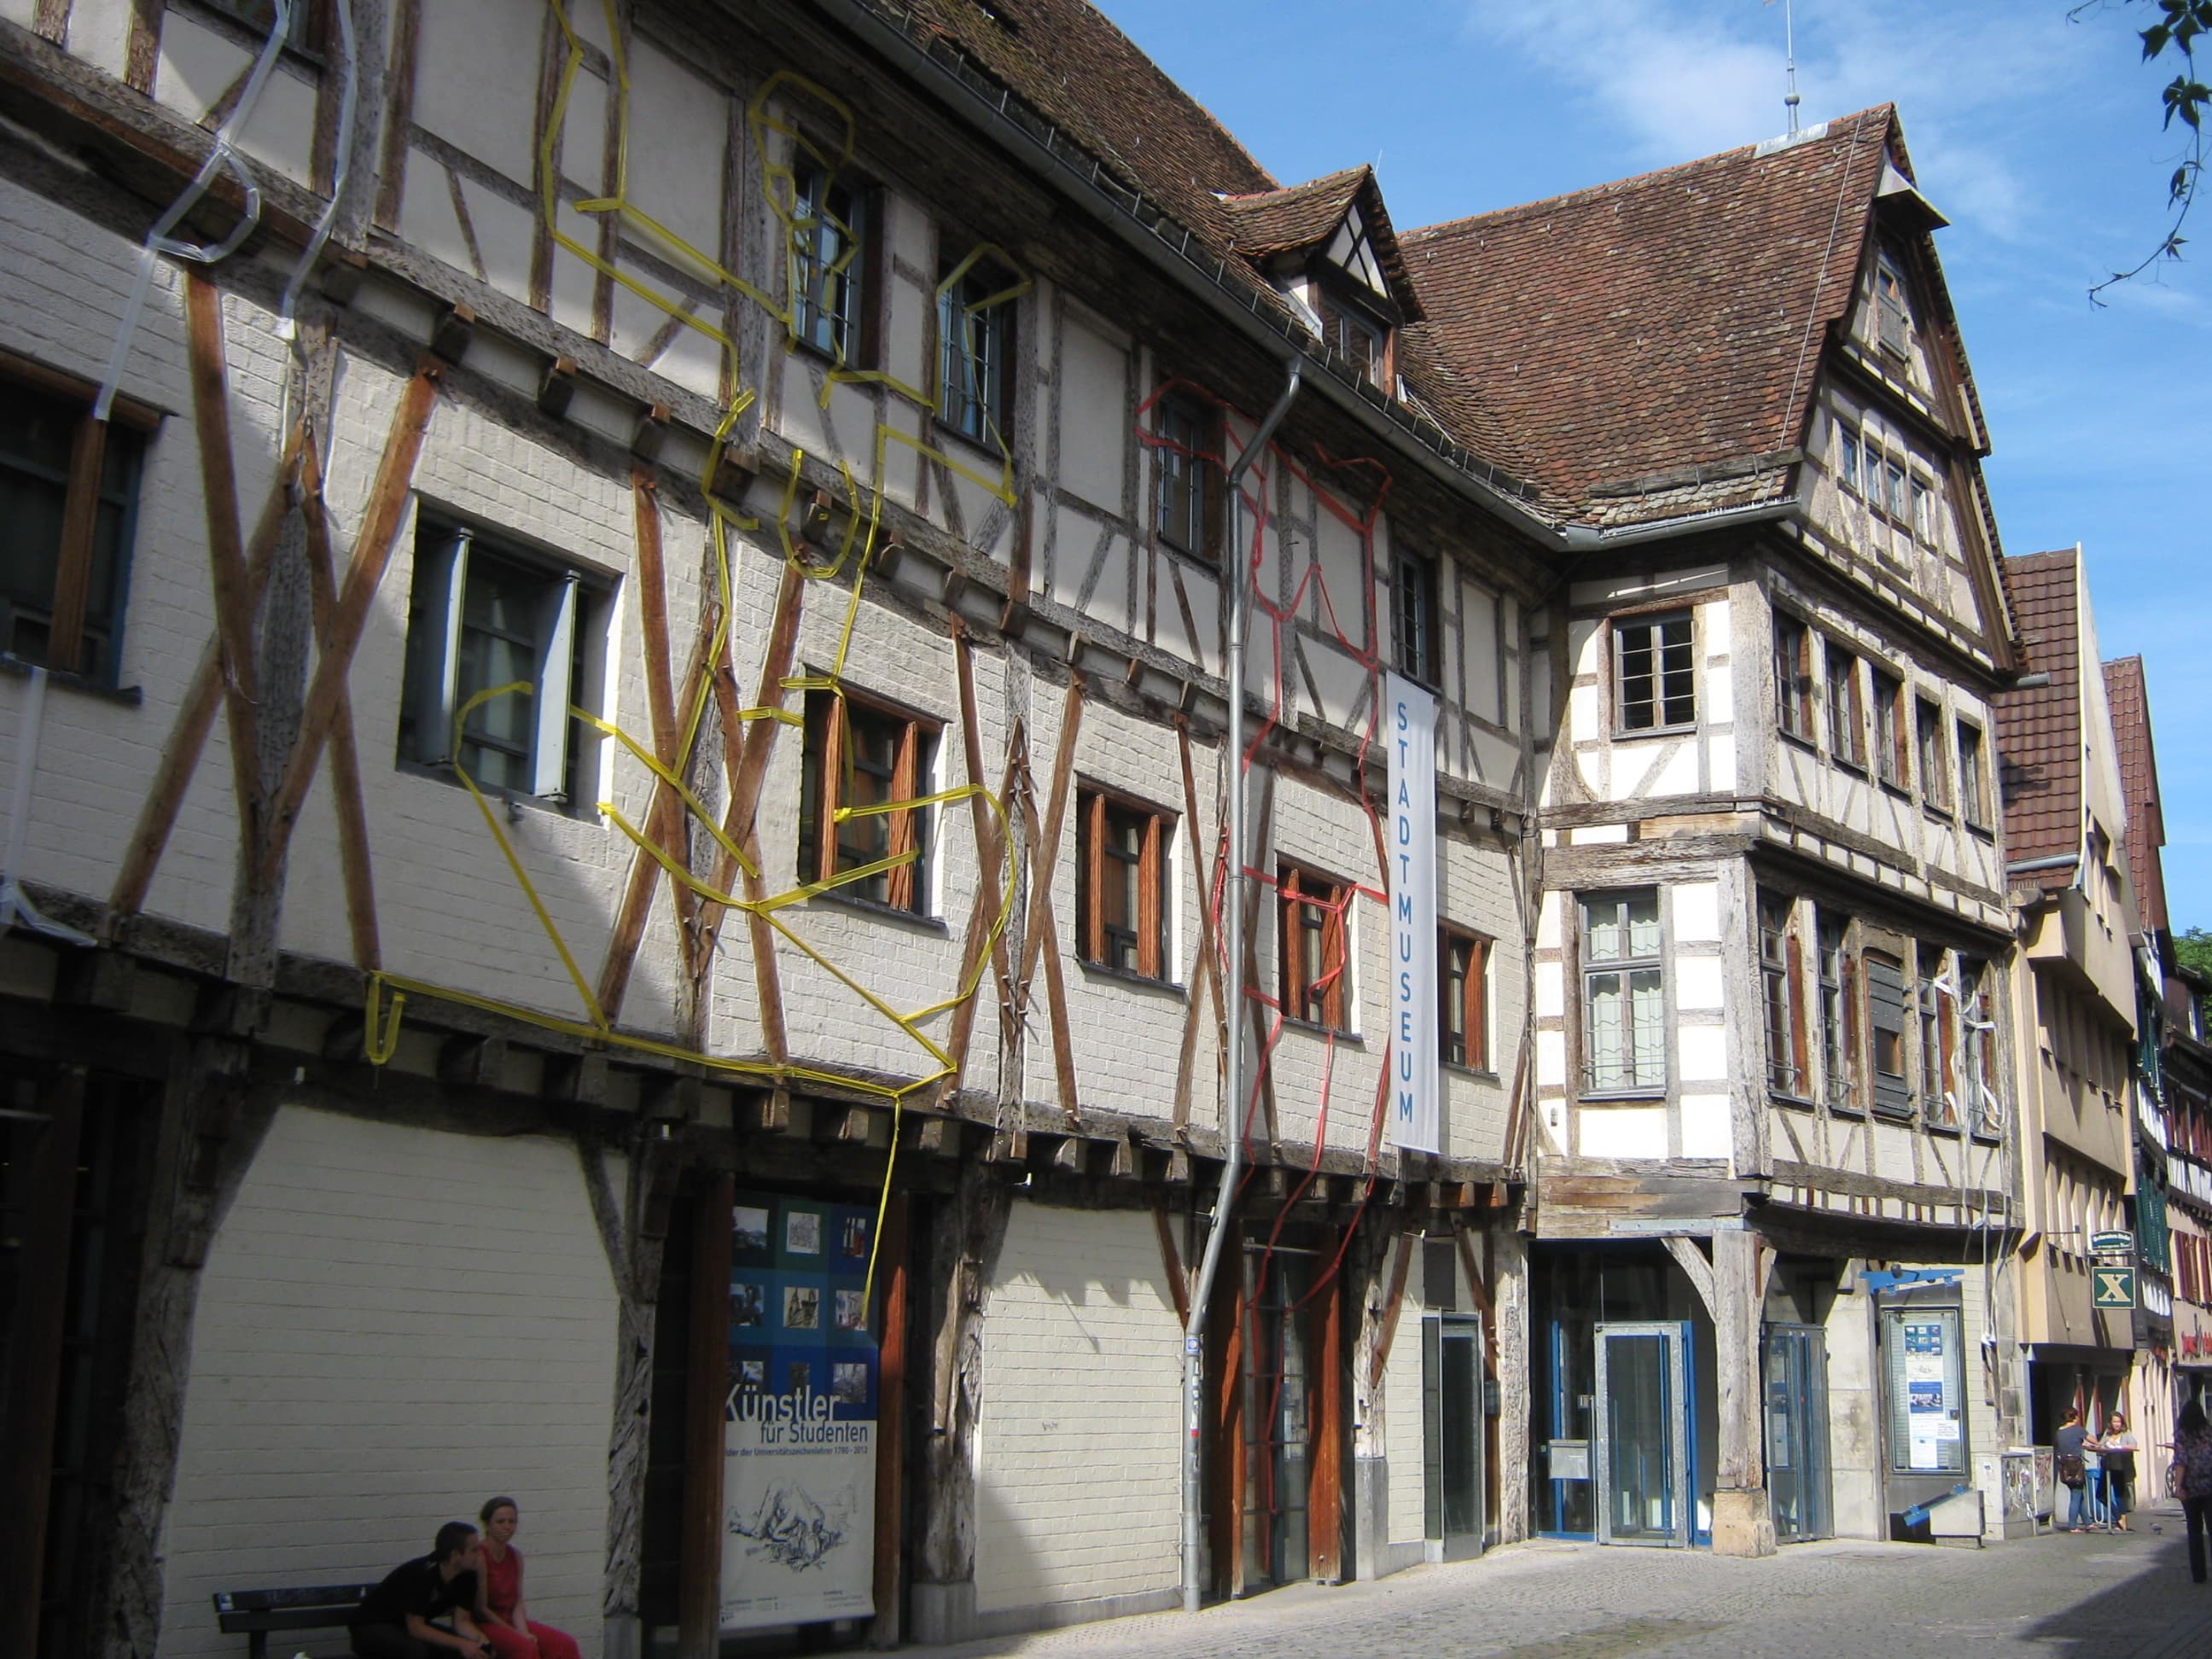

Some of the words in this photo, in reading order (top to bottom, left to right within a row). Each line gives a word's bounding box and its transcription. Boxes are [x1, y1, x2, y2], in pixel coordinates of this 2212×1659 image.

[1397, 701, 1413, 1123] STADTMUSEUM
[2097, 1273, 2131, 1302] X
[725, 1383, 841, 1421] Künstler
[761, 1421, 783, 1443] für
[789, 1421, 868, 1443] Studenten
